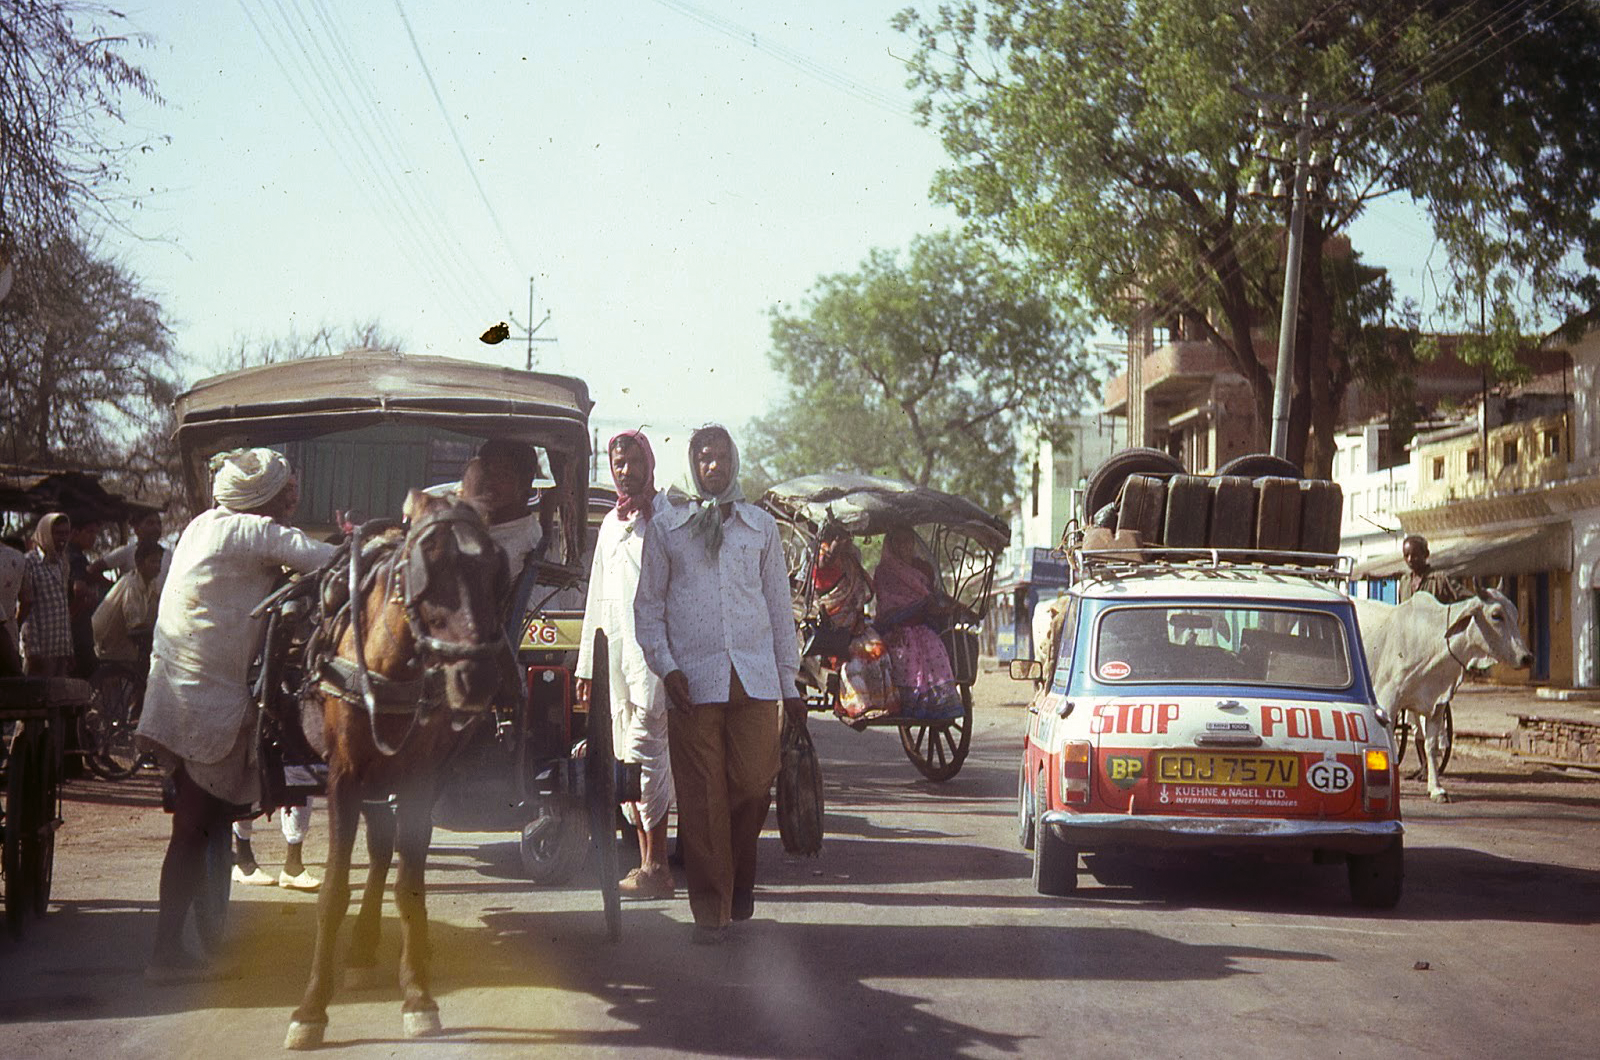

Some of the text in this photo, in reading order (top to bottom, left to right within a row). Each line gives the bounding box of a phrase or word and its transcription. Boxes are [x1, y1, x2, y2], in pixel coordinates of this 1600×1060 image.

[1090, 704, 1369, 743] STOP POLIO
[1110, 758, 1142, 780] BP
[1223, 758, 1293, 782] 757V
[1312, 766, 1349, 790] GB
[1175, 786, 1218, 796] KUEHNE
[1229, 787, 1259, 797] NAGEL
[1265, 789, 1288, 799] LTD.
[1176, 797, 1229, 805] INTERNATIONAL
